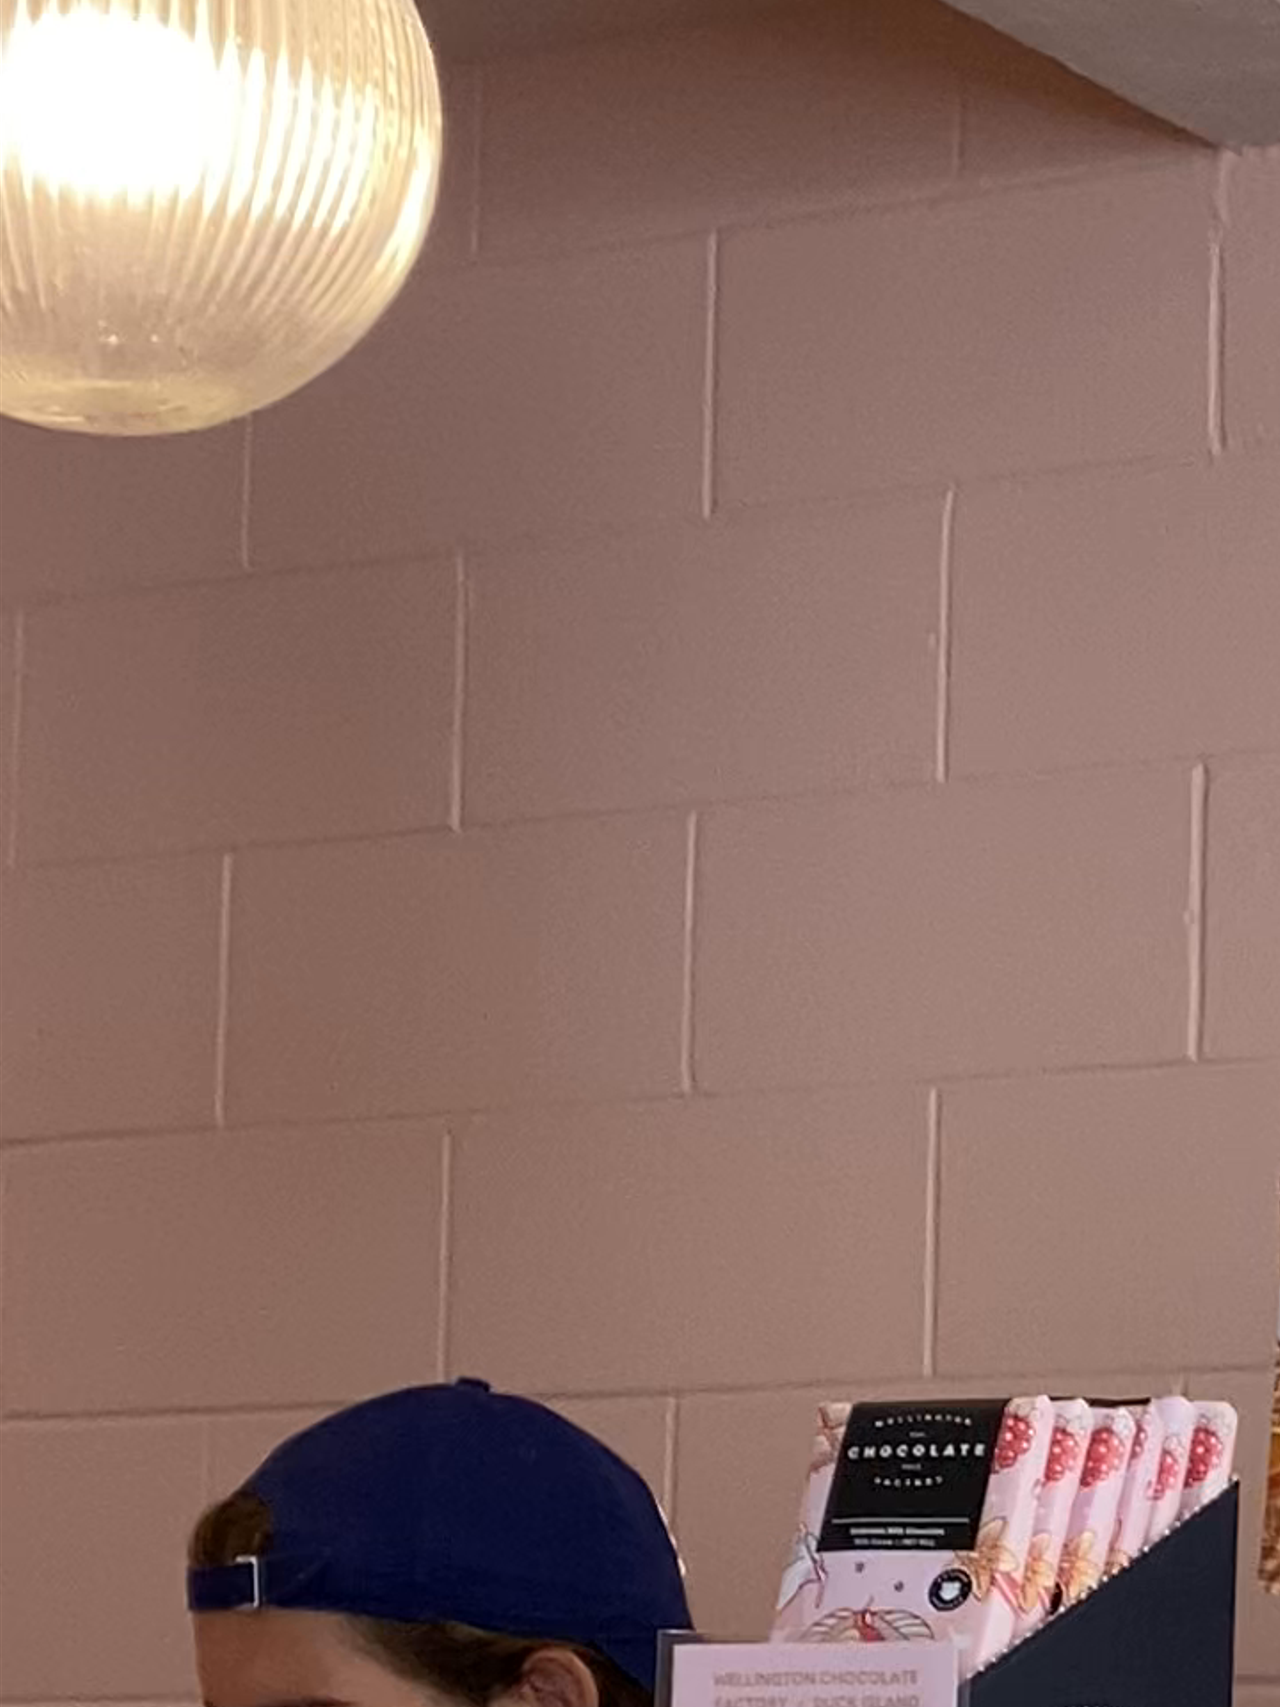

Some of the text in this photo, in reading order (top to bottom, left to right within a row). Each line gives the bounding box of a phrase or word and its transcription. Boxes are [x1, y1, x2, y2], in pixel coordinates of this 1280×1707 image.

[847, 1443, 986, 1460] CHOCOLATE
[713, 1670, 918, 1687] WELLINGTON CHOCOLATE
